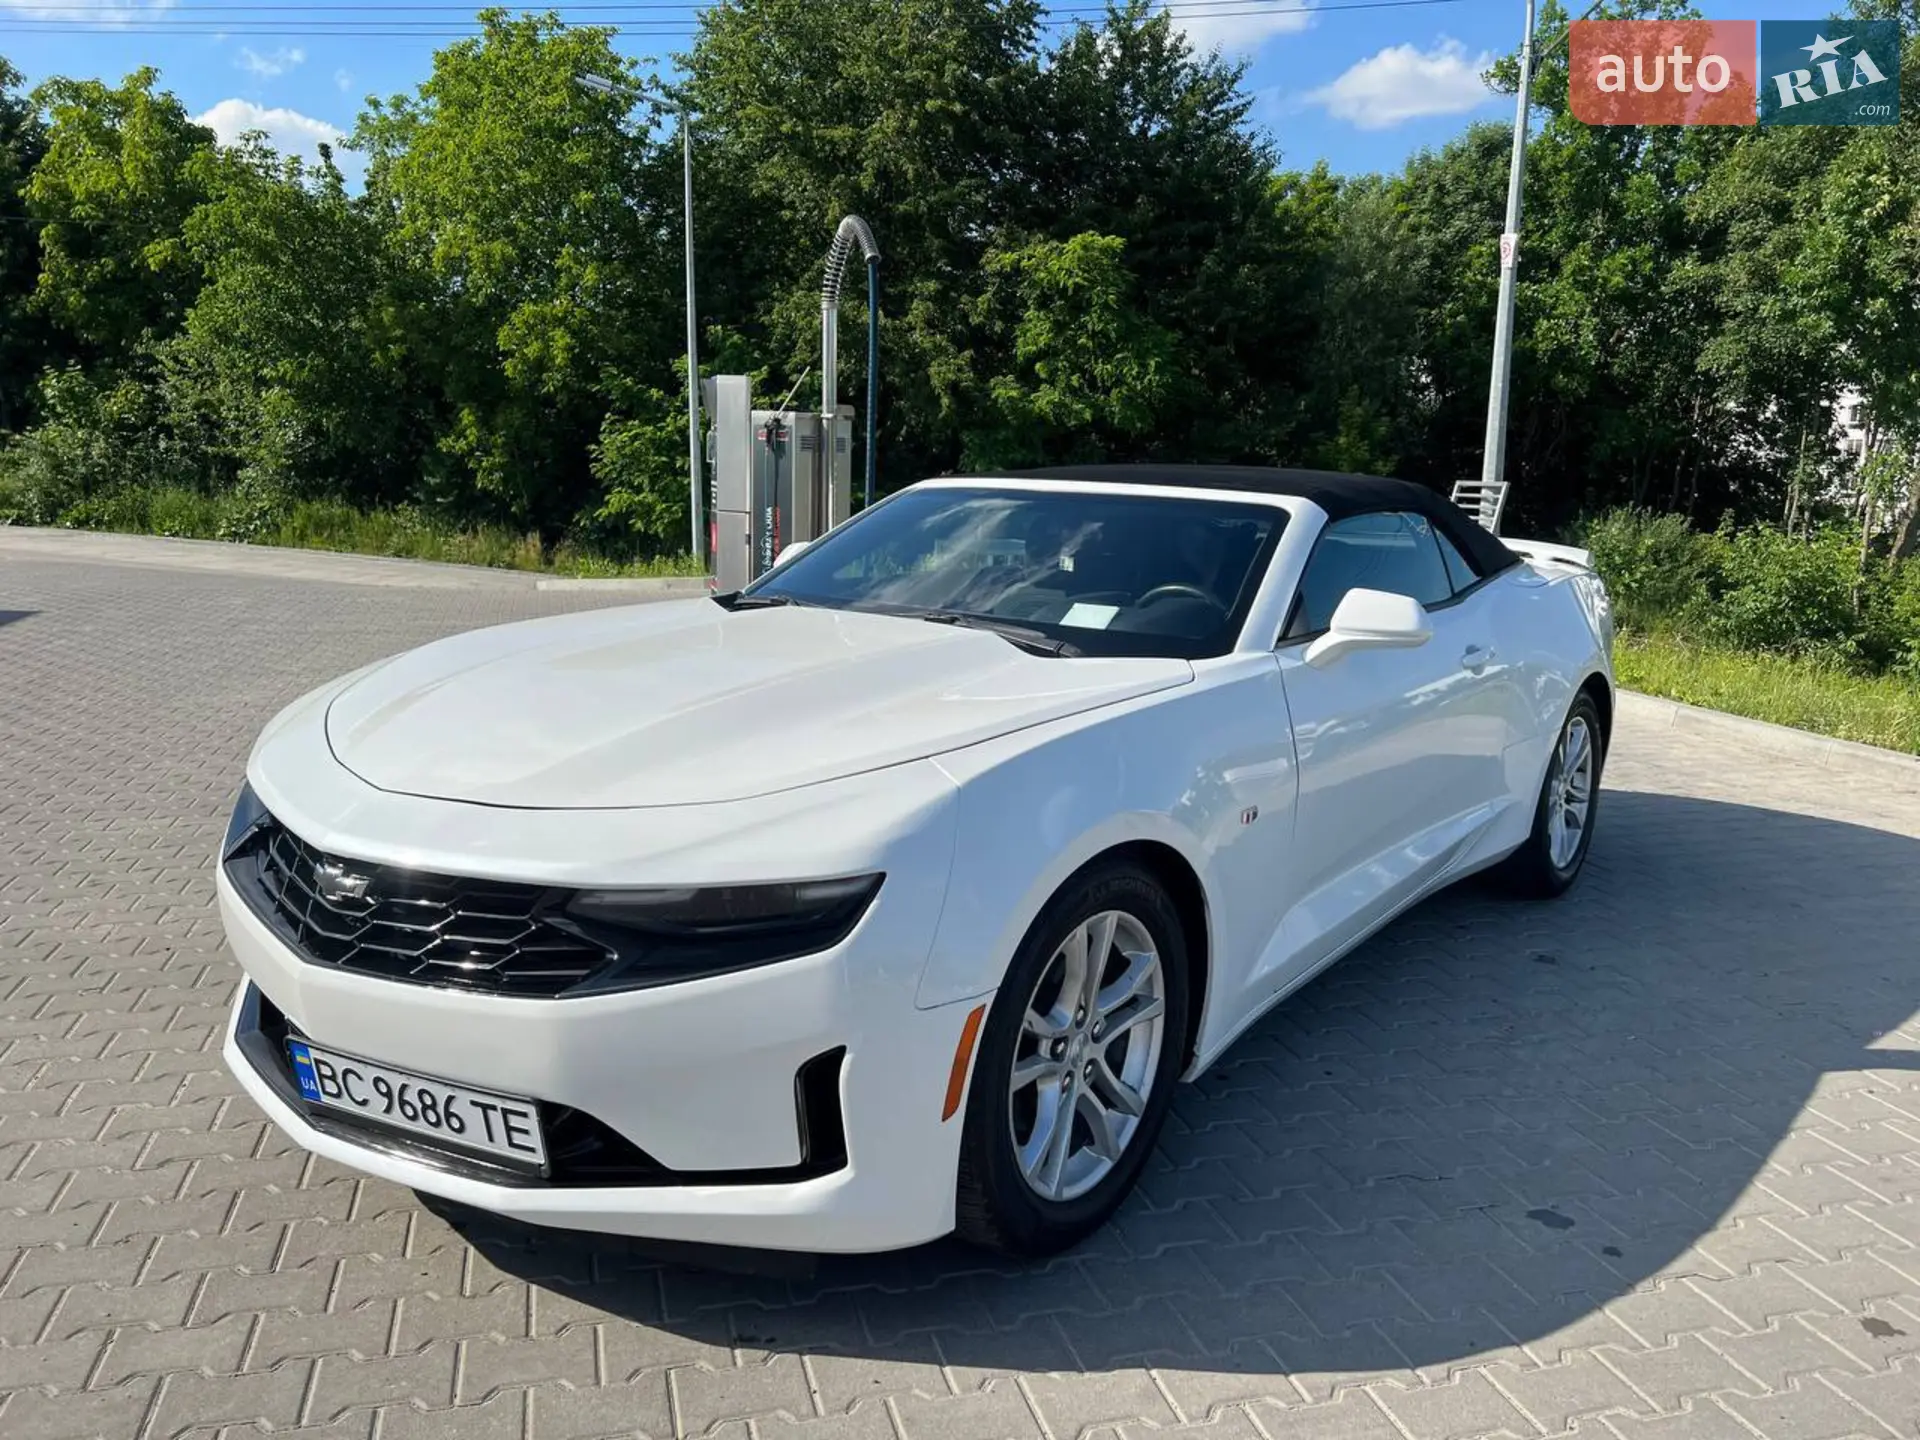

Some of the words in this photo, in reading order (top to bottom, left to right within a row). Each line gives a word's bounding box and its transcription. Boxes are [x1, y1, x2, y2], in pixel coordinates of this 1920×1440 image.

[300, 1076, 318, 1093] UA
[313, 1057, 369, 1107] BC
[372, 1076, 466, 1135] 9686
[469, 1099, 537, 1154] TE
